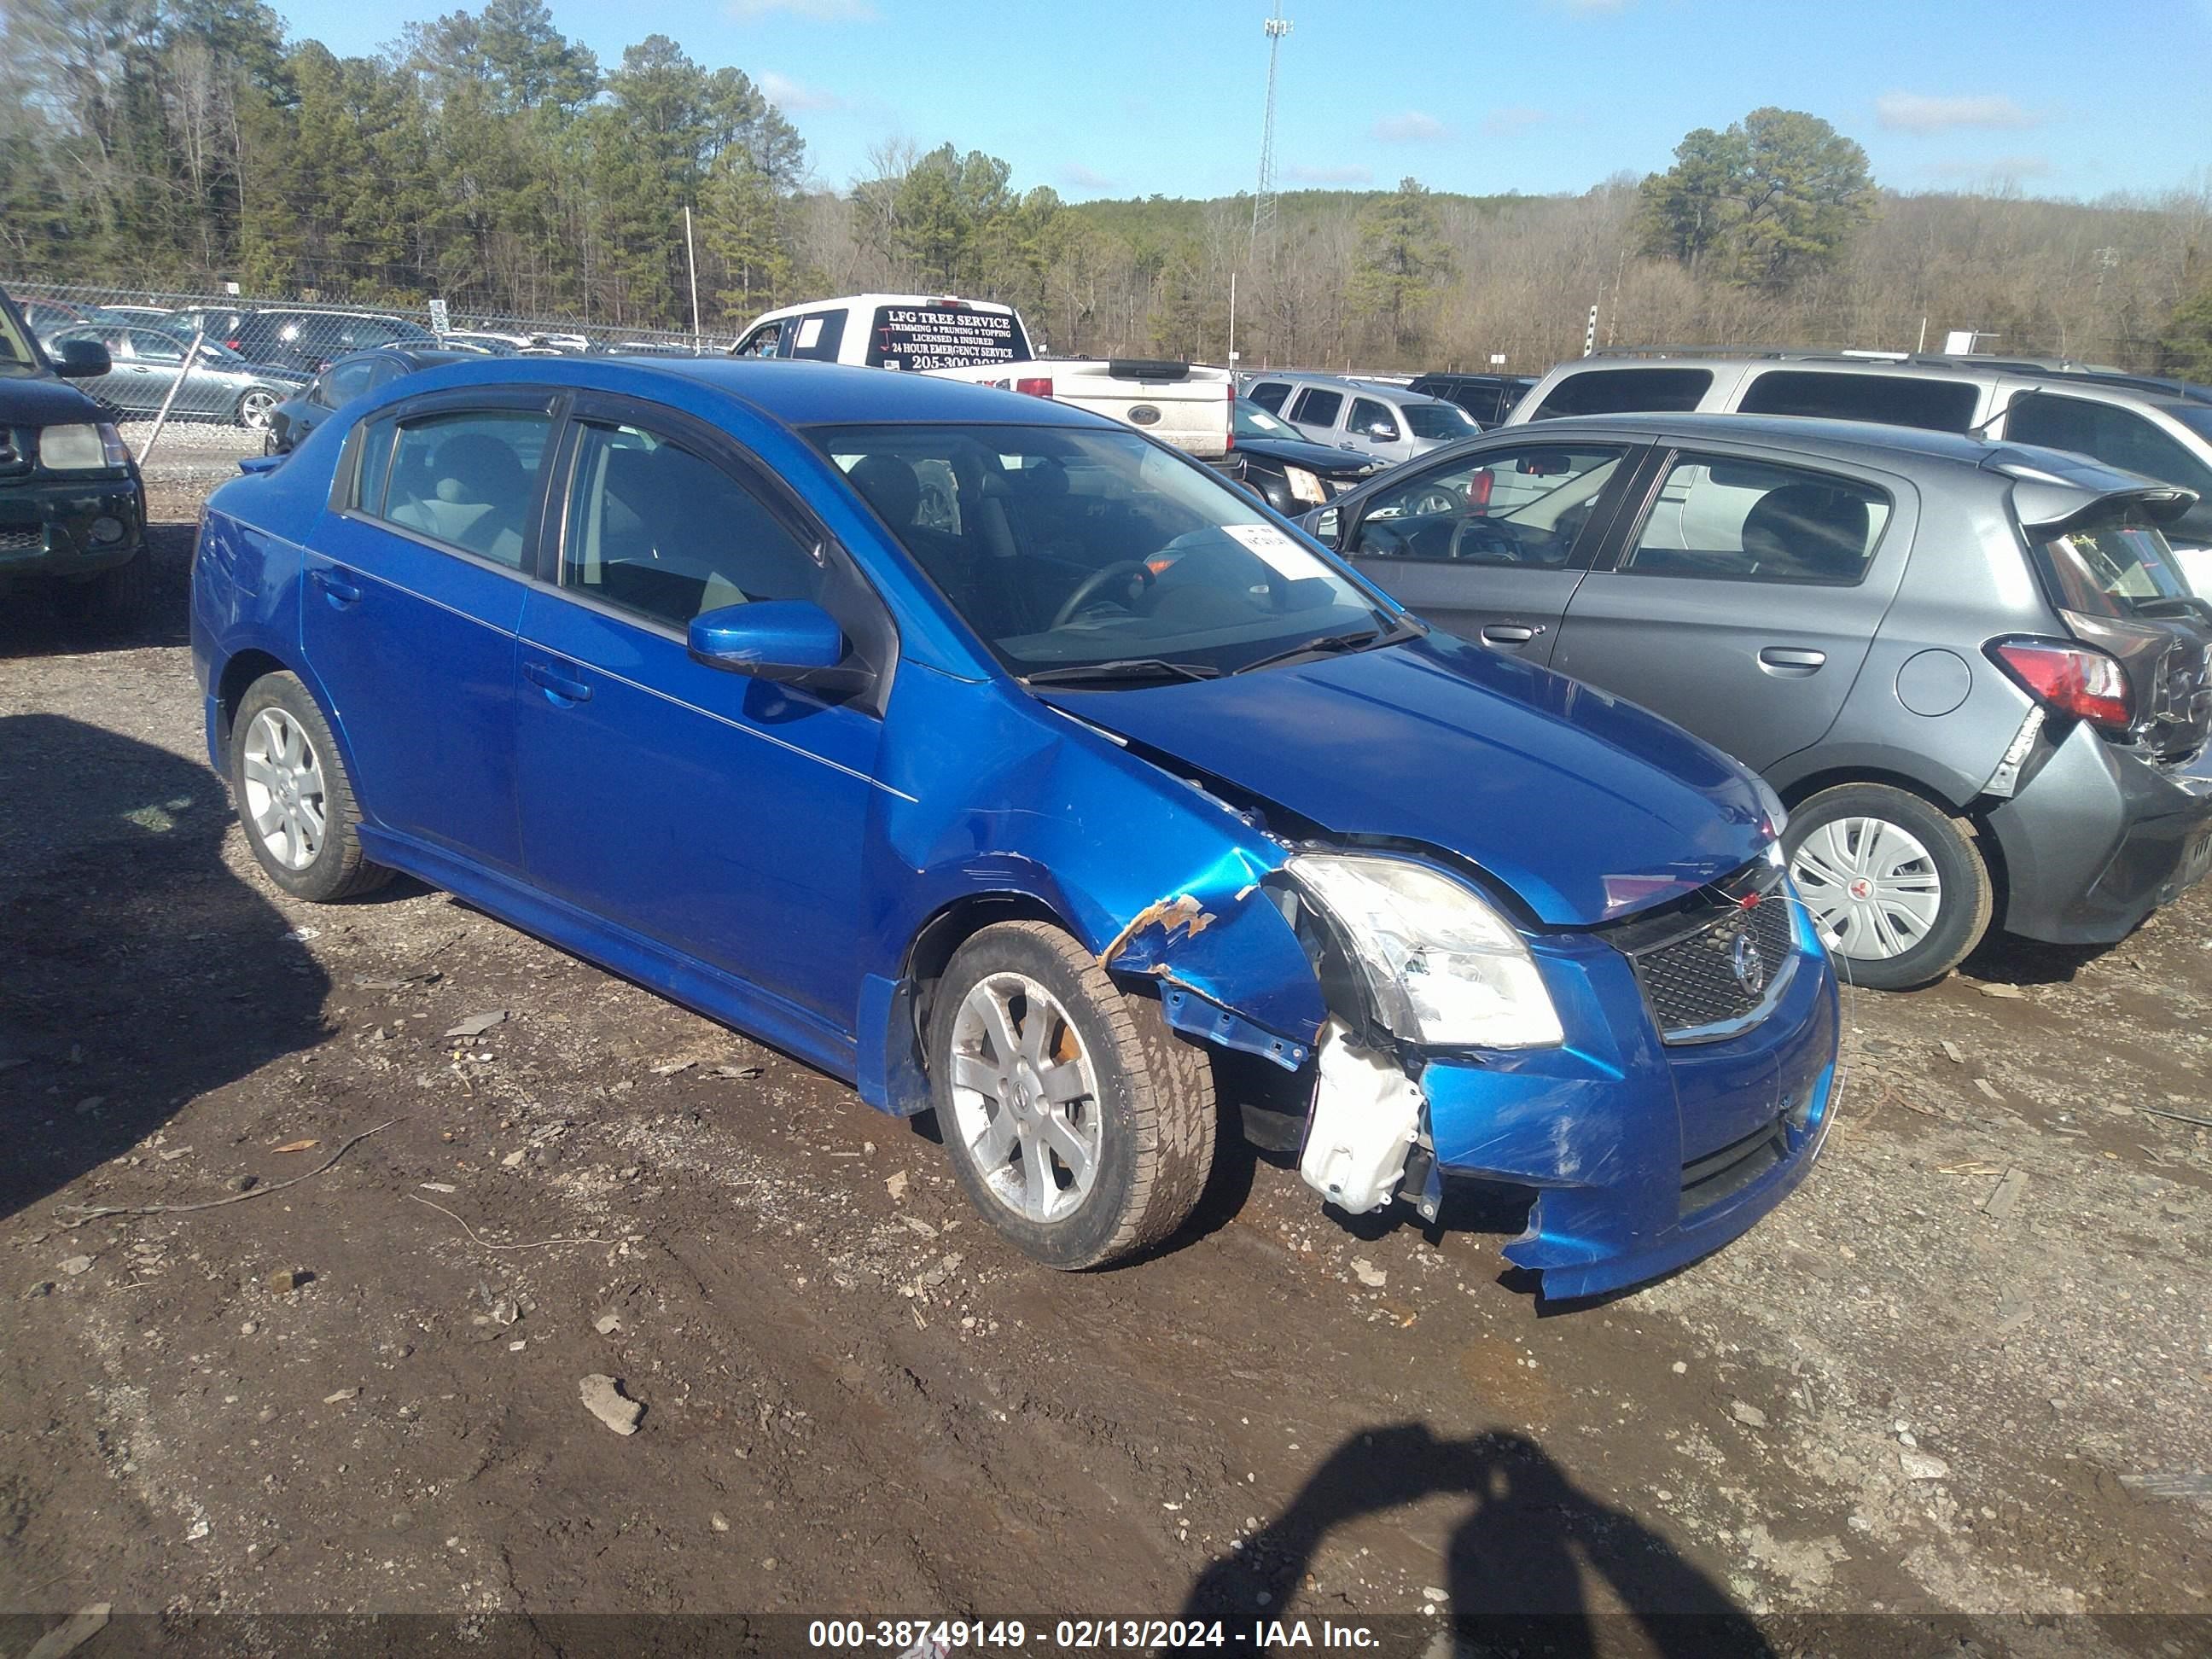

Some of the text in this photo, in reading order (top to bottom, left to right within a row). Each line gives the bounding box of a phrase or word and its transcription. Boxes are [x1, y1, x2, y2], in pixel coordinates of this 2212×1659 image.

[888, 310, 1010, 329] LFG TREE SERVICE
[889, 323, 1011, 338] TRIMMING PRUNING TOPPING
[912, 334, 952, 343] LICENSED
[959, 336, 994, 346] INSURED
[892, 343, 1014, 358] 24 HOUR EMERGENCY SERVICE
[912, 355, 1004, 370] 205-300
